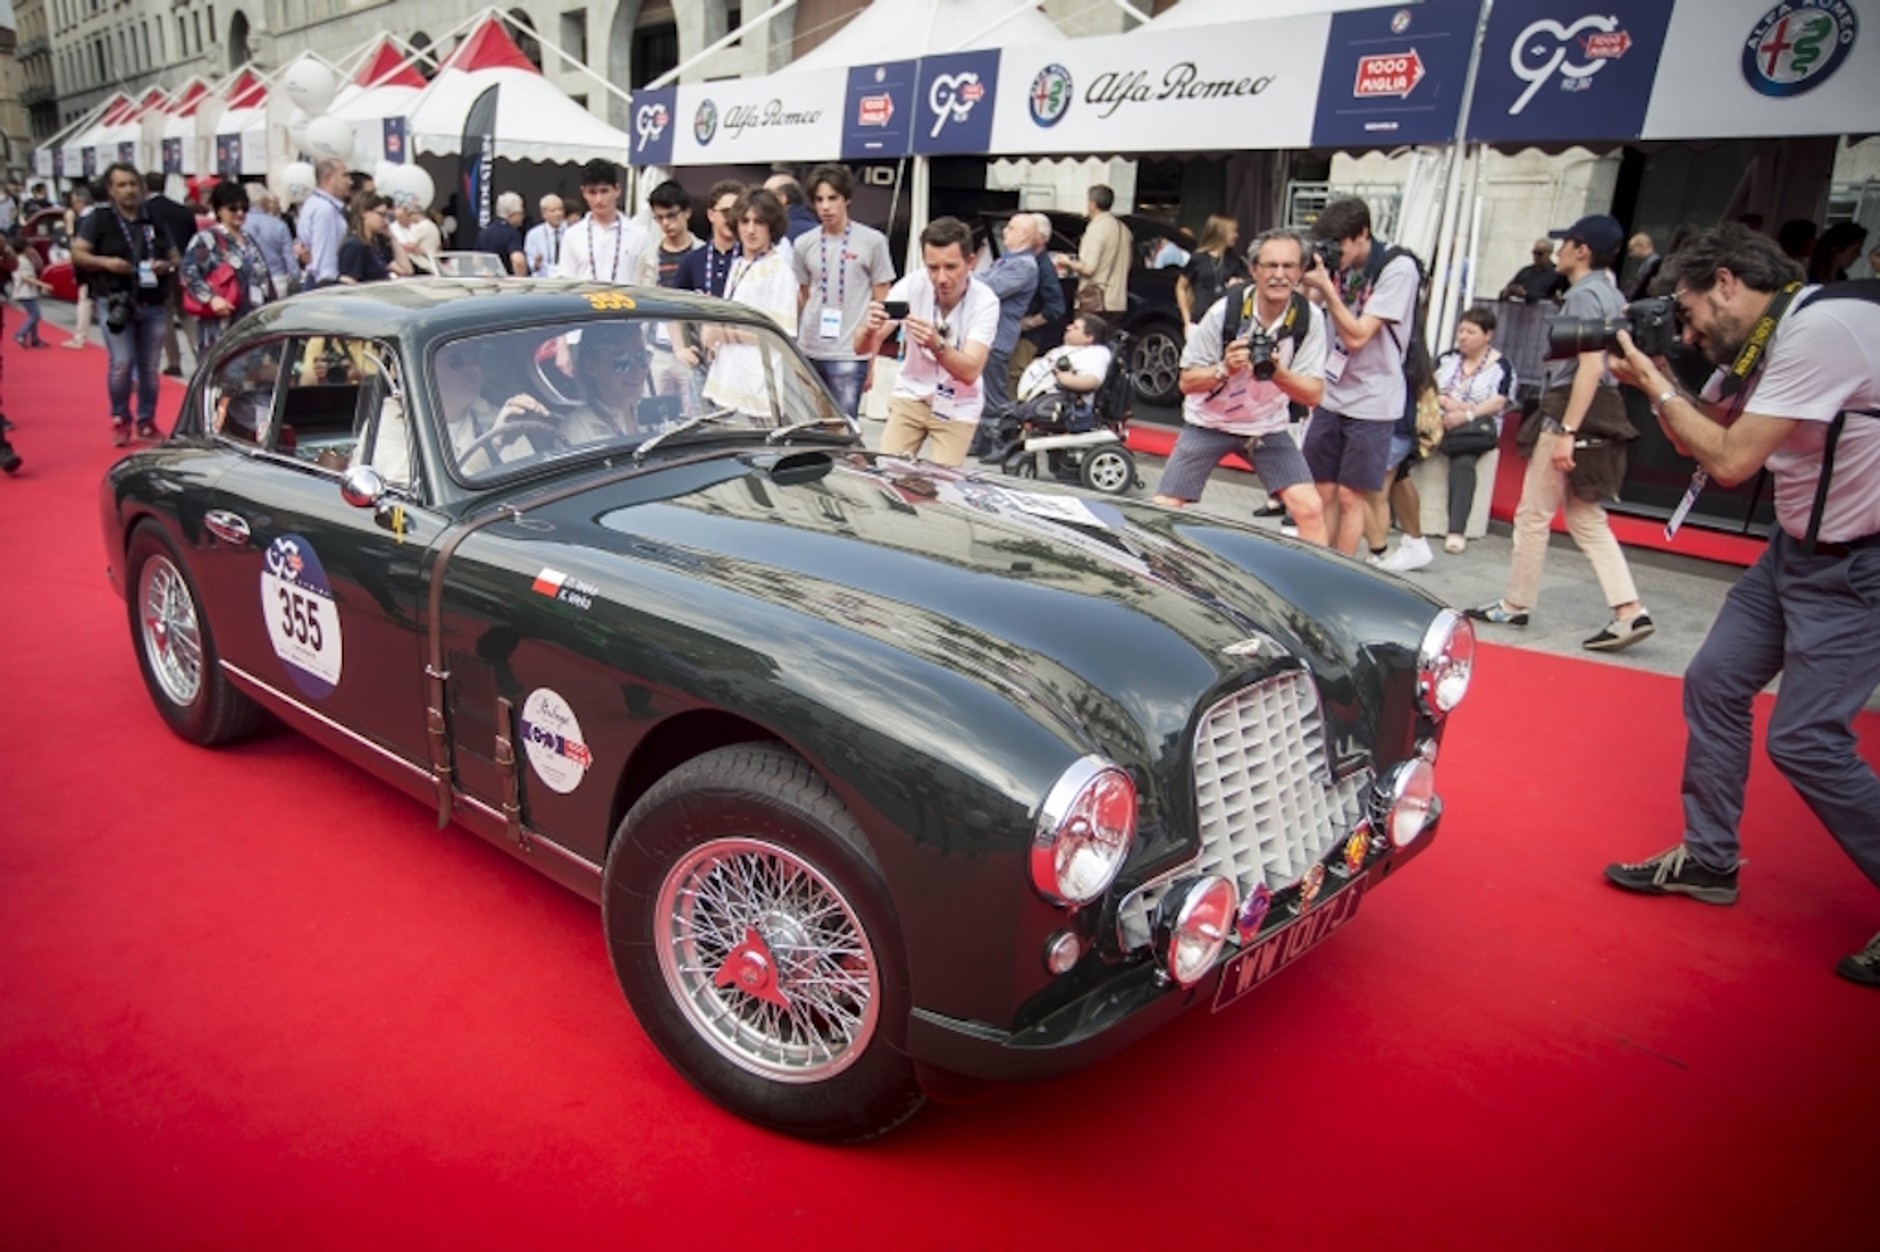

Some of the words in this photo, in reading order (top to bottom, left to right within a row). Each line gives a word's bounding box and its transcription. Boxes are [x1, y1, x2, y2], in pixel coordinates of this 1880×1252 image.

[1748, 3, 1793, 50] ALFA
[1360, 76, 1408, 92] MIGLIA
[1367, 59, 1408, 75] 1000
[1085, 70, 1152, 119] Alfa
[1157, 61, 1277, 100] Romeo
[723, 105, 760, 140] Alfa
[762, 98, 822, 126] Romeo
[278, 587, 323, 652] 355
